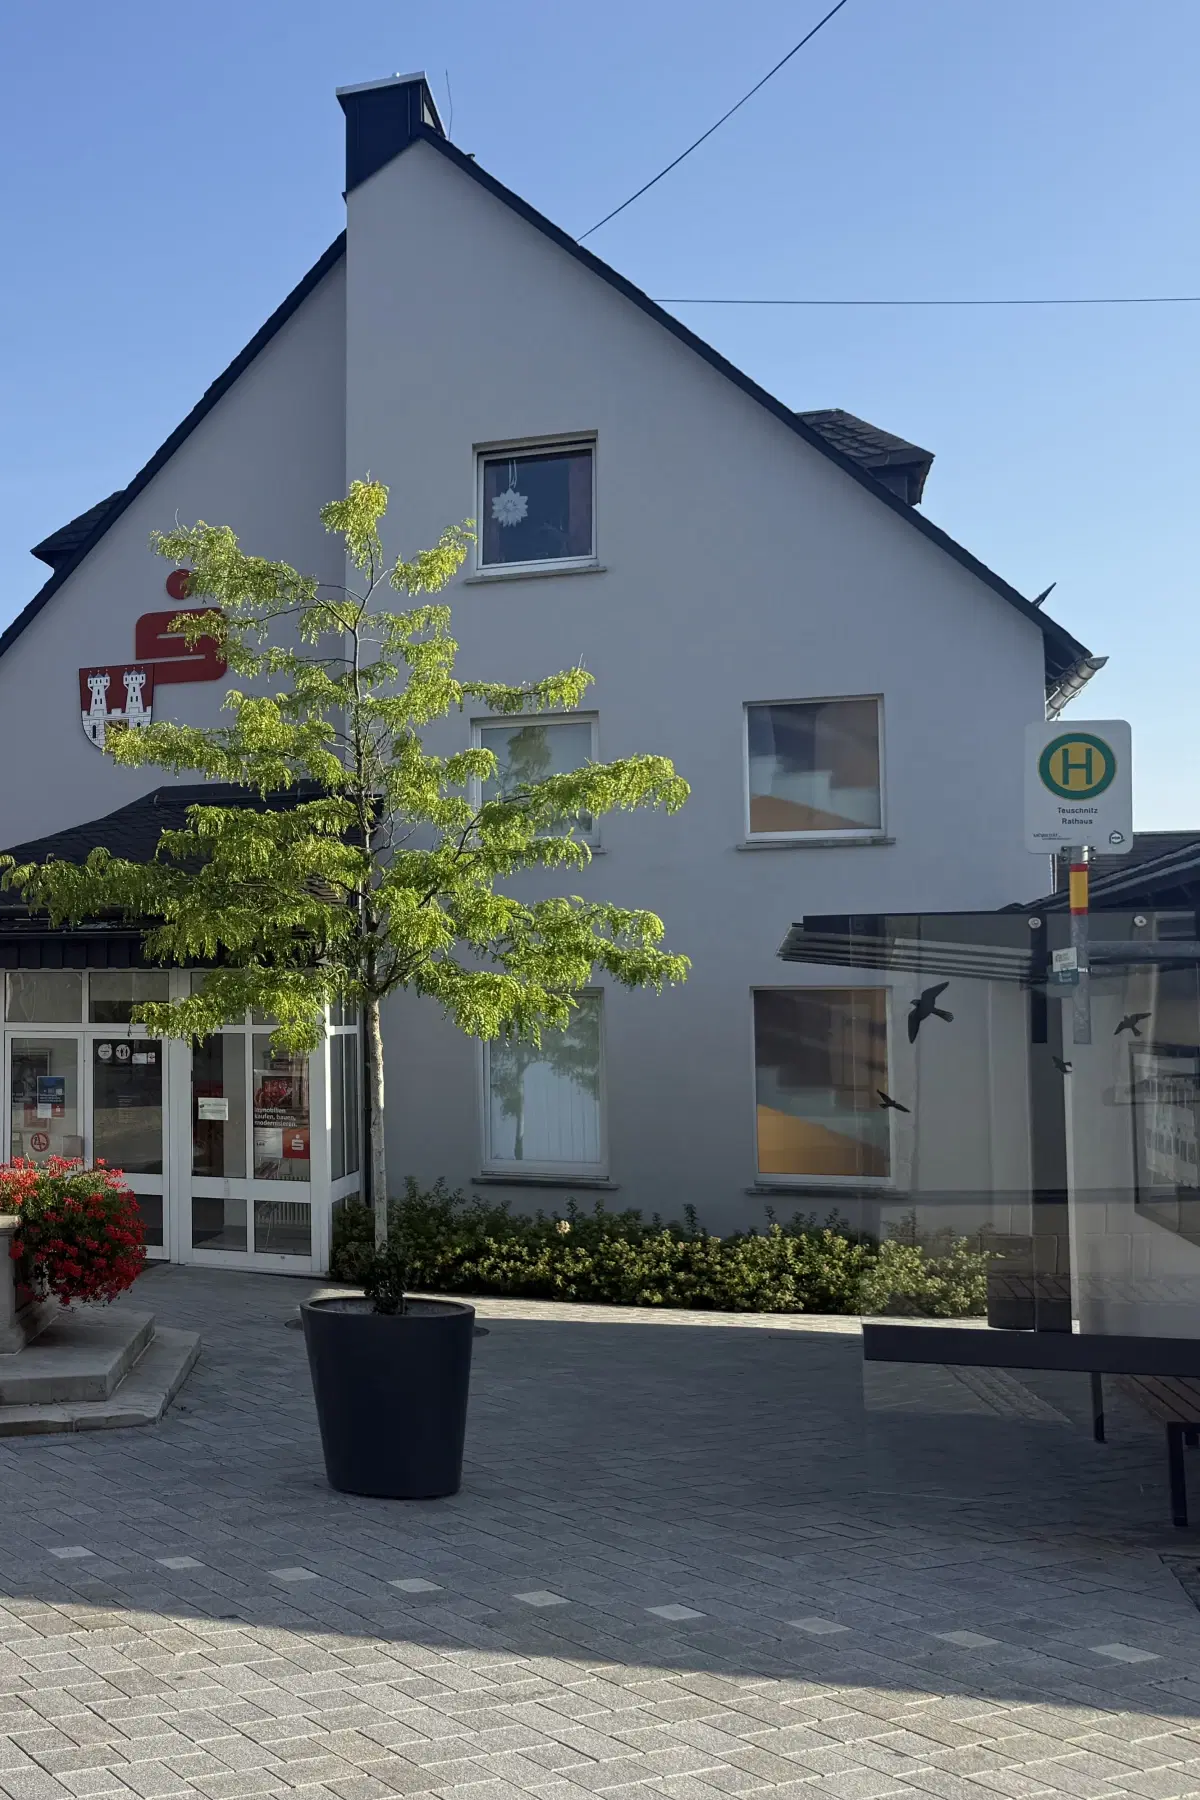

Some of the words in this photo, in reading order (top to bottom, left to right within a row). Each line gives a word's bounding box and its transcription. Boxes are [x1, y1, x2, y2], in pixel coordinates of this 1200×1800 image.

[1061, 747, 1093, 785] H
[1057, 806, 1099, 814] Teuschnitz
[1061, 817, 1093, 825] Rathaus
